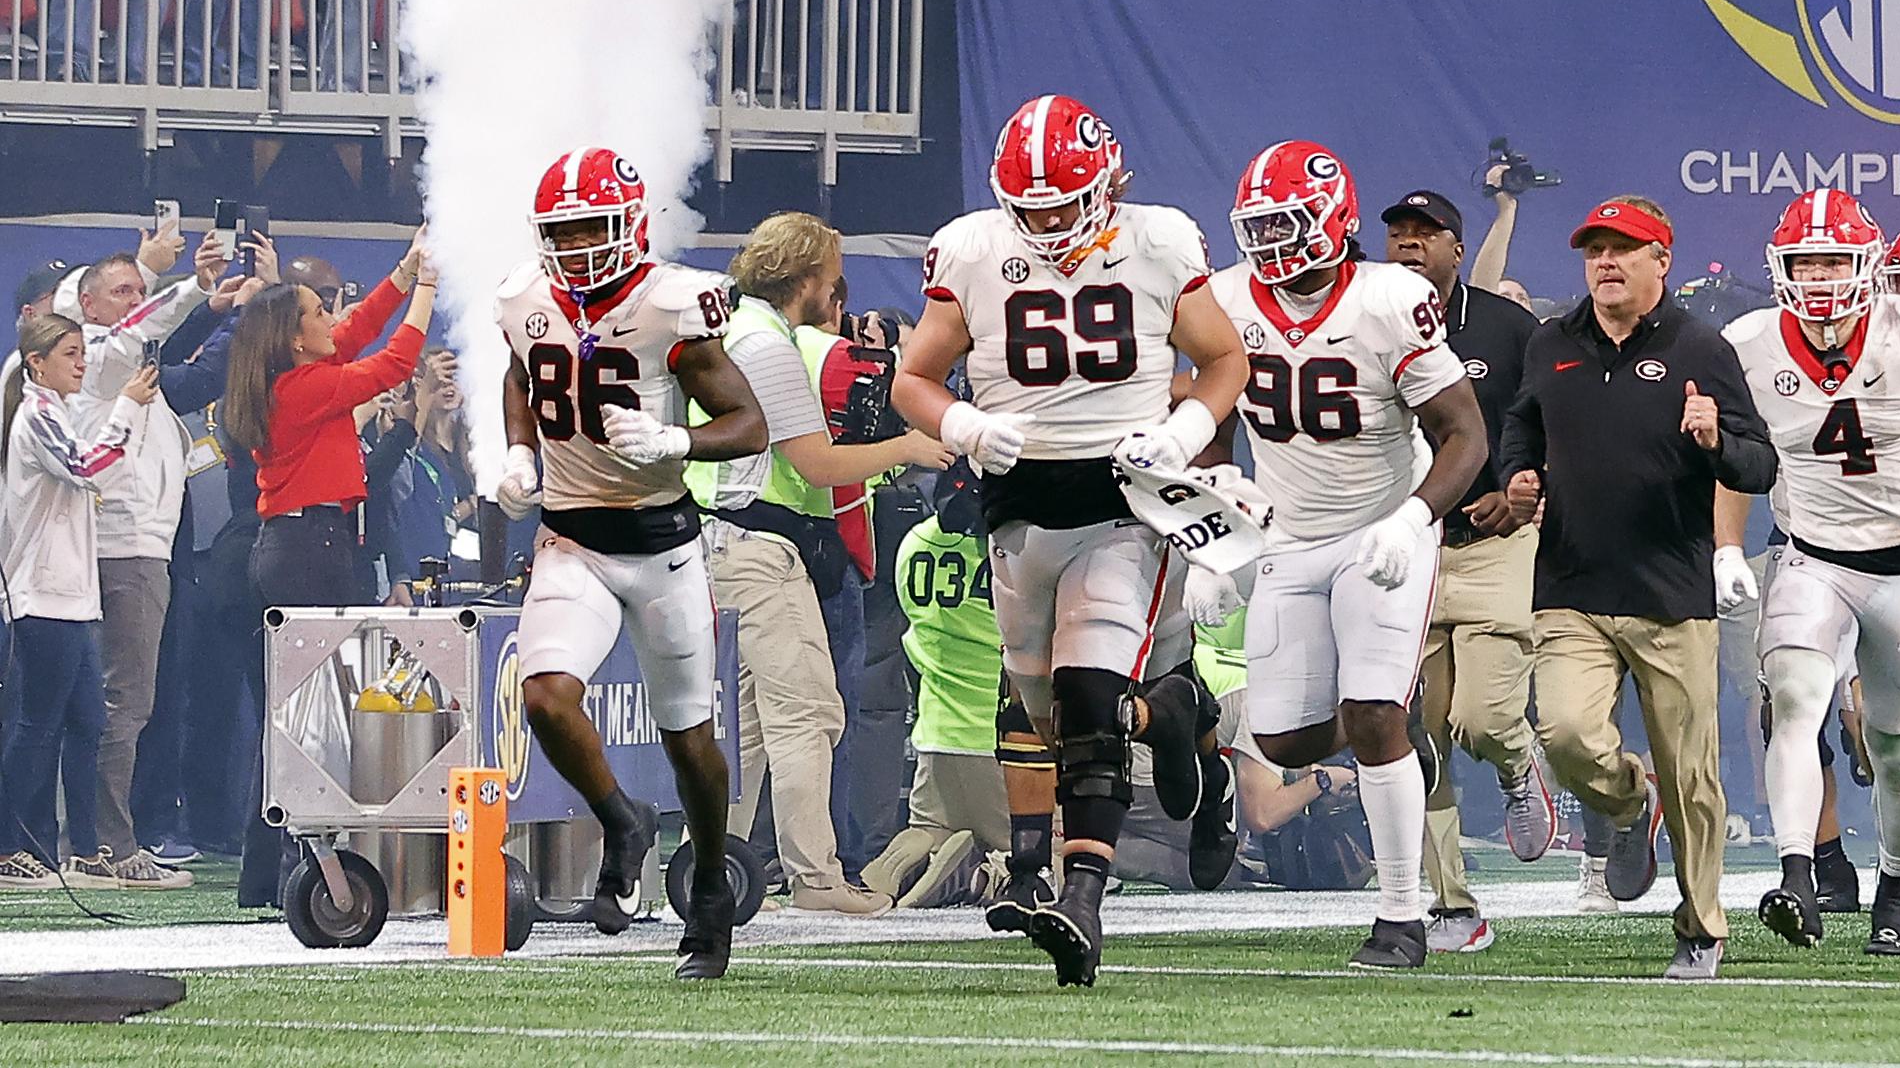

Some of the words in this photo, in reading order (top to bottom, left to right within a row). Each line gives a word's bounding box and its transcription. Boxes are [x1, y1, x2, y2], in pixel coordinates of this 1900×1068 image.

[613, 155, 642, 186] G
[1304, 153, 1342, 181] G
[1598, 206, 1620, 219] G
[1003, 258, 1030, 283] SEC
[1005, 282, 1138, 389] 69
[1285, 328, 1306, 343] G
[1635, 359, 1668, 381] G
[1819, 378, 1840, 391] G
[529, 343, 641, 444] 86
[1243, 353, 1362, 443] 96
[1812, 397, 1879, 477] 4
[908, 551, 994, 609] 034
